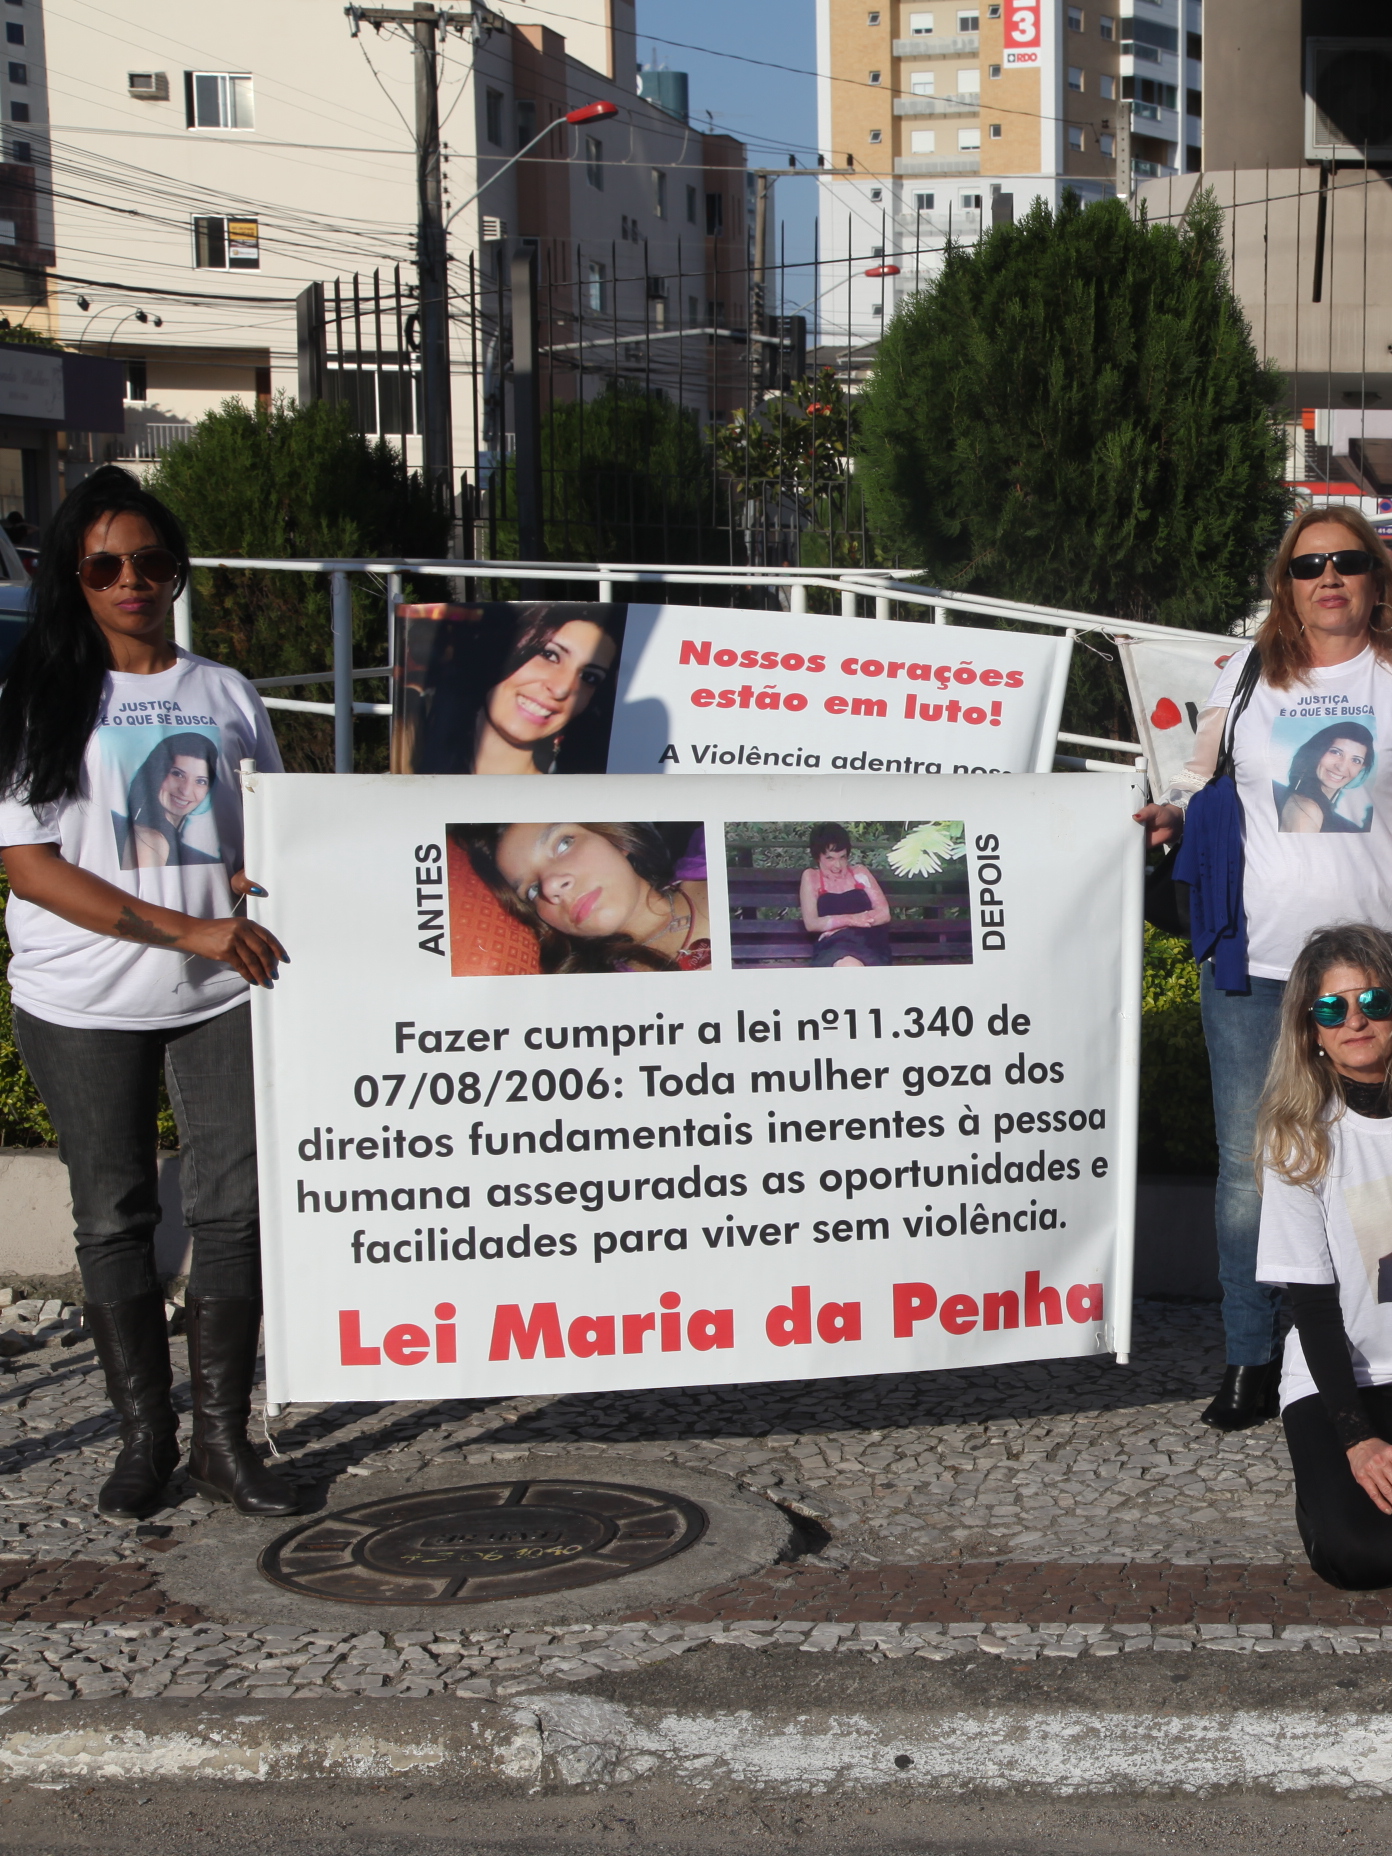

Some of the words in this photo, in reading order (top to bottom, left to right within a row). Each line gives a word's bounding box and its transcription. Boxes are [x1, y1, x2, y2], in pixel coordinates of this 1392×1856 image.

[1017, 53, 1037, 62] RDO
[680, 641, 825, 672] Nossos
[841, 658, 1023, 690] corações
[113, 715, 122, 725] O
[126, 715, 153, 726] QUE
[156, 713, 172, 725] SE
[175, 715, 217, 726] BUSCA
[119, 700, 182, 713] JUSTIÇA
[691, 685, 808, 711] estão
[825, 696, 887, 717] em
[905, 694, 1002, 726] luto!
[1280, 707, 1287, 717] É
[1289, 708, 1297, 717] O
[1300, 707, 1321, 717] QUE
[1324, 706, 1338, 716] SE
[1341, 704, 1375, 716] BUSCA
[1297, 694, 1349, 706] JUSTIÇA
[658, 743, 681, 764] A
[691, 744, 821, 768] Violência
[830, 750, 942, 774] adentra
[415, 844, 445, 956] ANTES
[976, 834, 1005, 950] DEPOIS
[396, 1022, 509, 1053] Fazer
[525, 1013, 683, 1055] cumprir
[698, 1022, 720, 1044] a
[738, 1009, 780, 1042] lei
[798, 1006, 973, 1040] nº11.340
[988, 1004, 1030, 1035] de
[355, 1068, 622, 1109] 07/08/2006:
[639, 1062, 734, 1096] Toda
[752, 1058, 889, 1092] mulher
[903, 1065, 990, 1096] goza
[1005, 1052, 1064, 1084] dos
[299, 1126, 453, 1161] direitos
[469, 1119, 752, 1155] fundamentais
[768, 1111, 944, 1143] inerentes
[959, 1105, 979, 1135] à
[995, 1109, 1105, 1143] pessoa
[298, 1180, 469, 1212] humana
[488, 1165, 747, 1211] asseguradas
[763, 1172, 804, 1194] as
[820, 1150, 1080, 1199] oportunidades
[1092, 1157, 1108, 1178] e
[352, 1224, 577, 1263] facilidades
[594, 1229, 687, 1263] para
[702, 1215, 799, 1248] viver
[813, 1218, 889, 1243] sem
[903, 1199, 1066, 1237] violência.
[339, 1303, 457, 1366] Lei
[489, 1292, 734, 1361] Maria
[766, 1286, 862, 1347] da
[893, 1271, 1103, 1338] Penha
